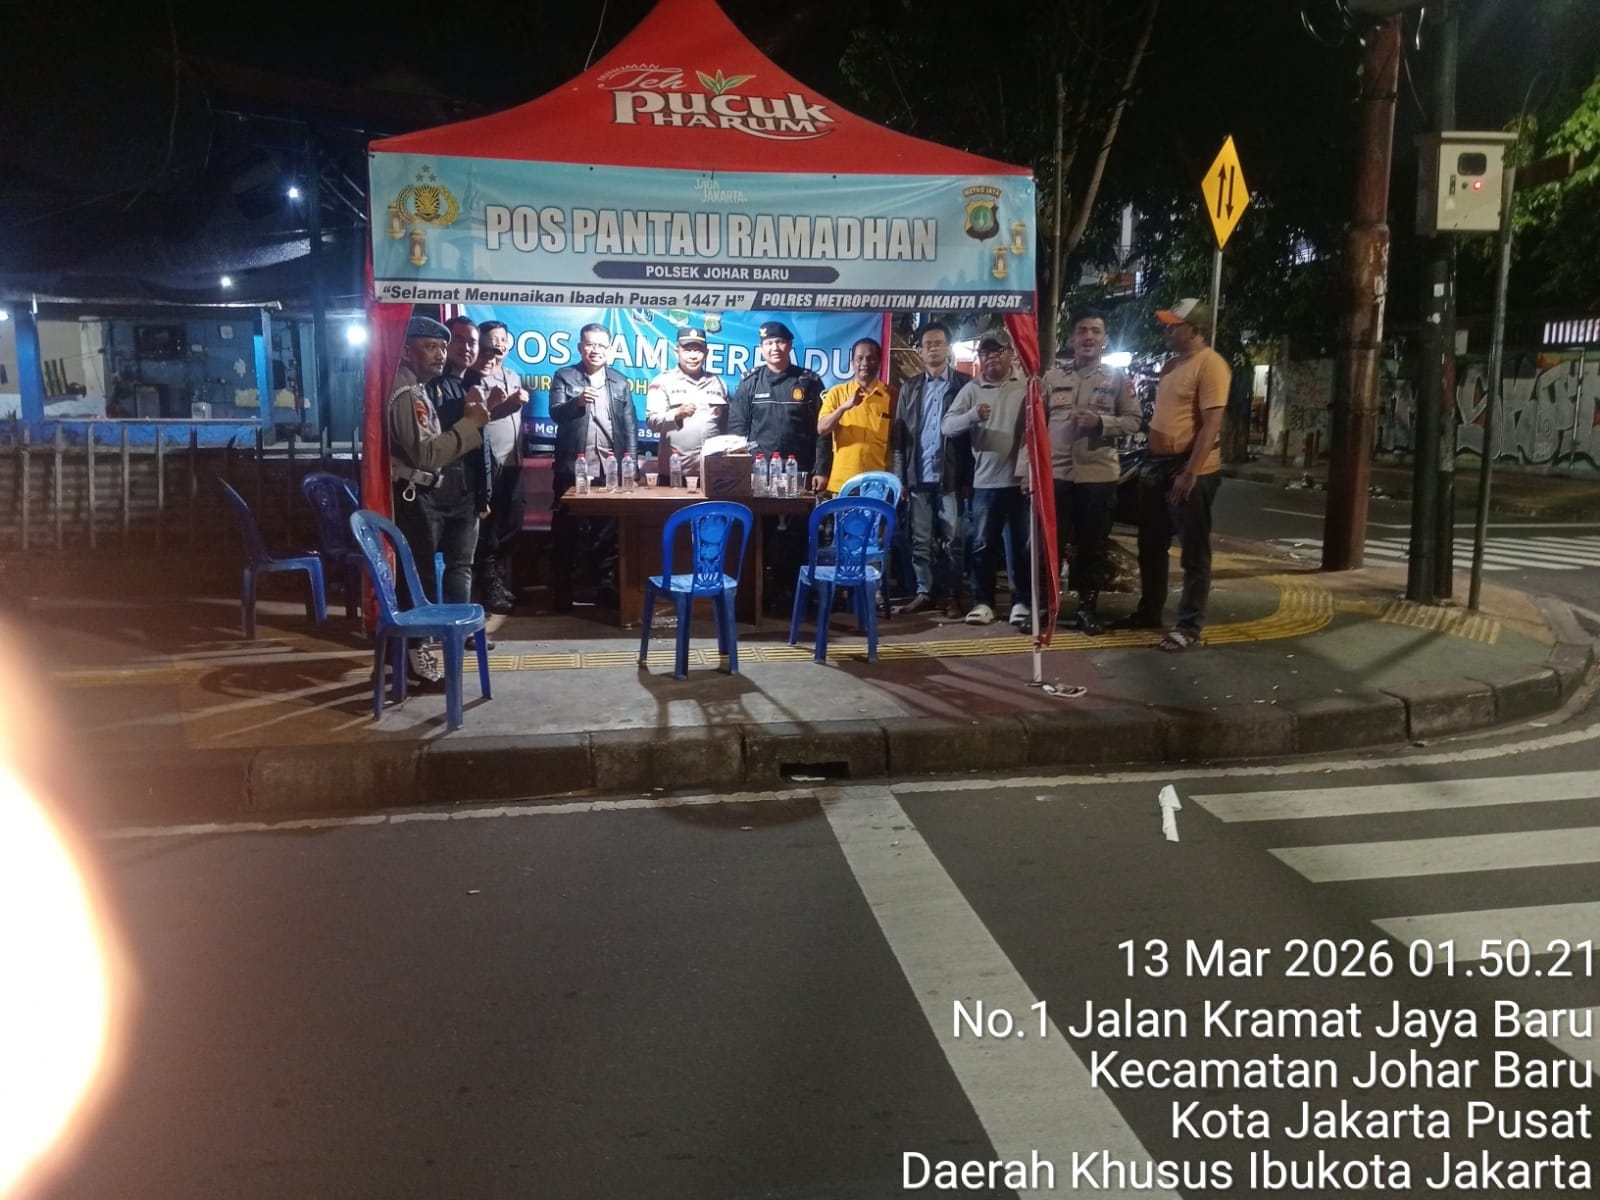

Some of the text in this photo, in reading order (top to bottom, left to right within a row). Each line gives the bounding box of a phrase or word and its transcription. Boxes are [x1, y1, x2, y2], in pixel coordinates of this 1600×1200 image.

[598, 67, 687, 90] Teh
[653, 112, 817, 133] HARUM
[484, 204, 937, 261] POS PANTAU RAMADHAN
[646, 265, 789, 280] POLSEK JOHAR BARU
[382, 285, 460, 300] “Selamat
[465, 287, 565, 304] Menunaikan
[570, 291, 624, 305] Ibadah
[629, 292, 677, 306] Puasa
[683, 294, 720, 307] 1447
[761, 293, 1022, 309] POLRES METROPOLITAN JAKARTA PUSAT
[608, 333, 670, 371] AM
